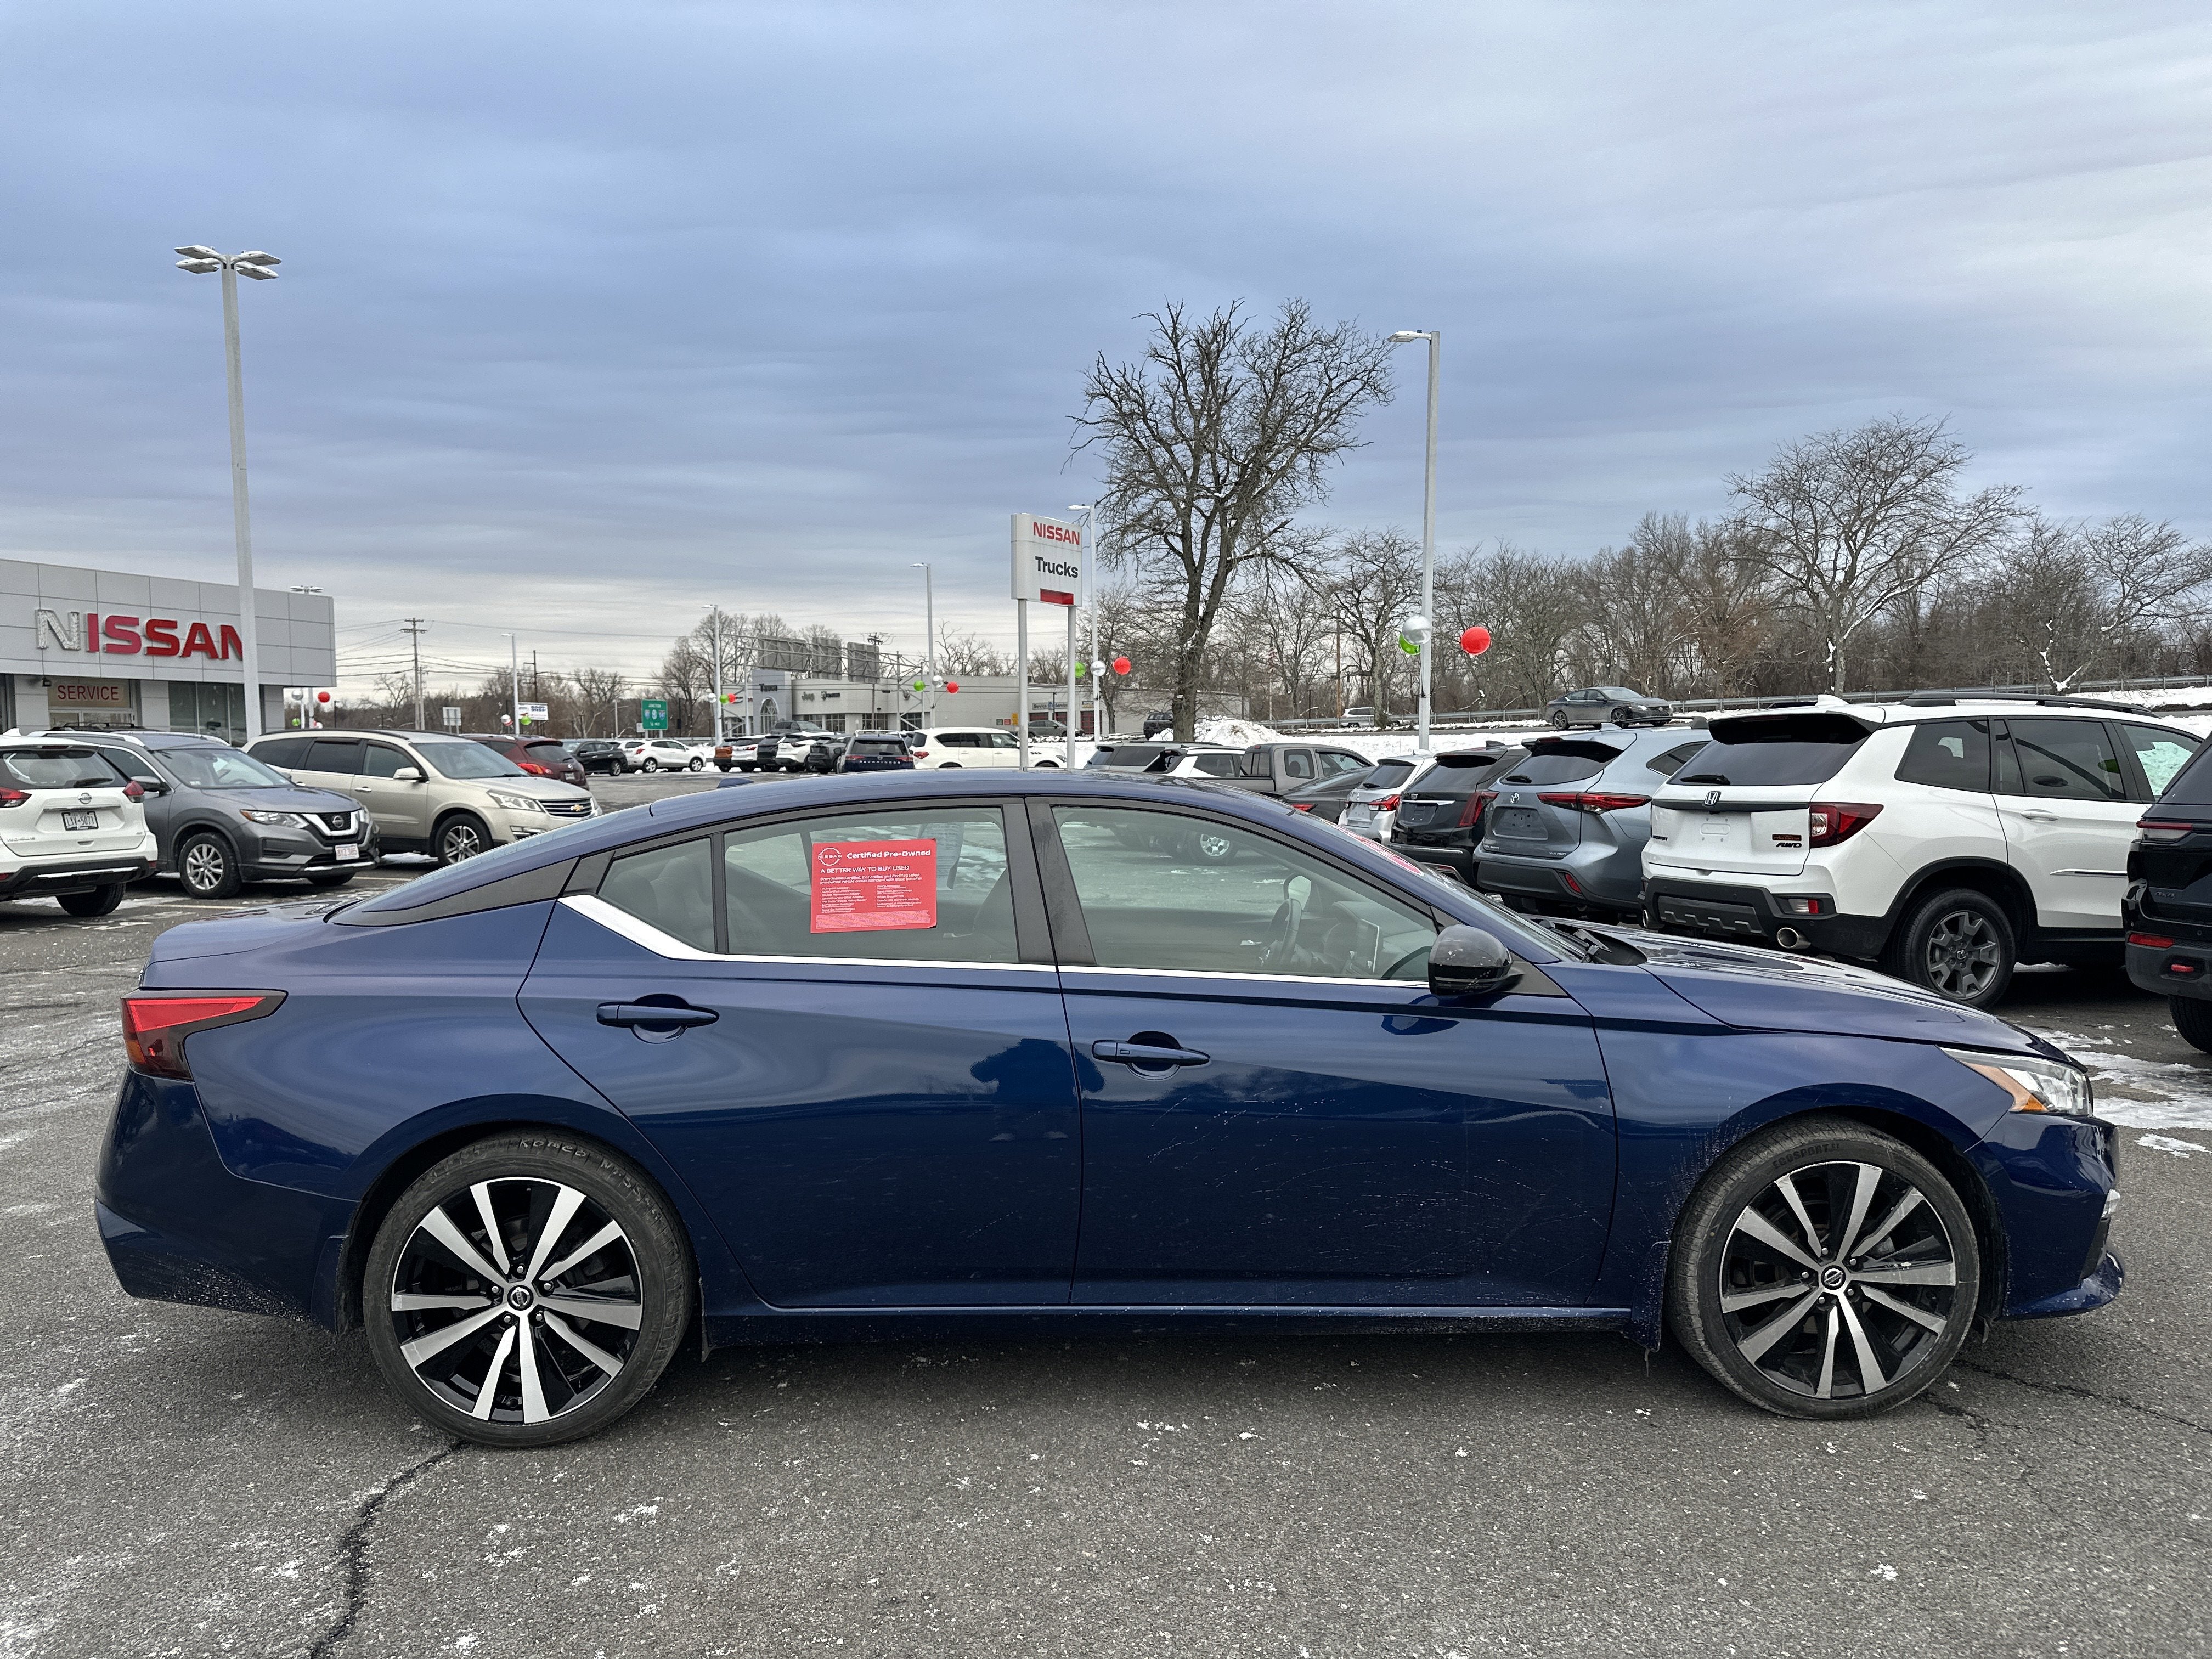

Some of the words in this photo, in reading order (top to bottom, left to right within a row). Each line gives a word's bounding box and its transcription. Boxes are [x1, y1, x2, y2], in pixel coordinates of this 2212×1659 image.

[1033, 521, 1080, 546] NISSAN
[1035, 556, 1079, 579] Trucks
[36, 608, 244, 662] NISSAN
[57, 685, 120, 701] SERVICE
[847, 851, 882, 860] Certified
[884, 849, 931, 858] Pre-Owned
[1772, 1143, 1829, 1170] ECOSPORT
